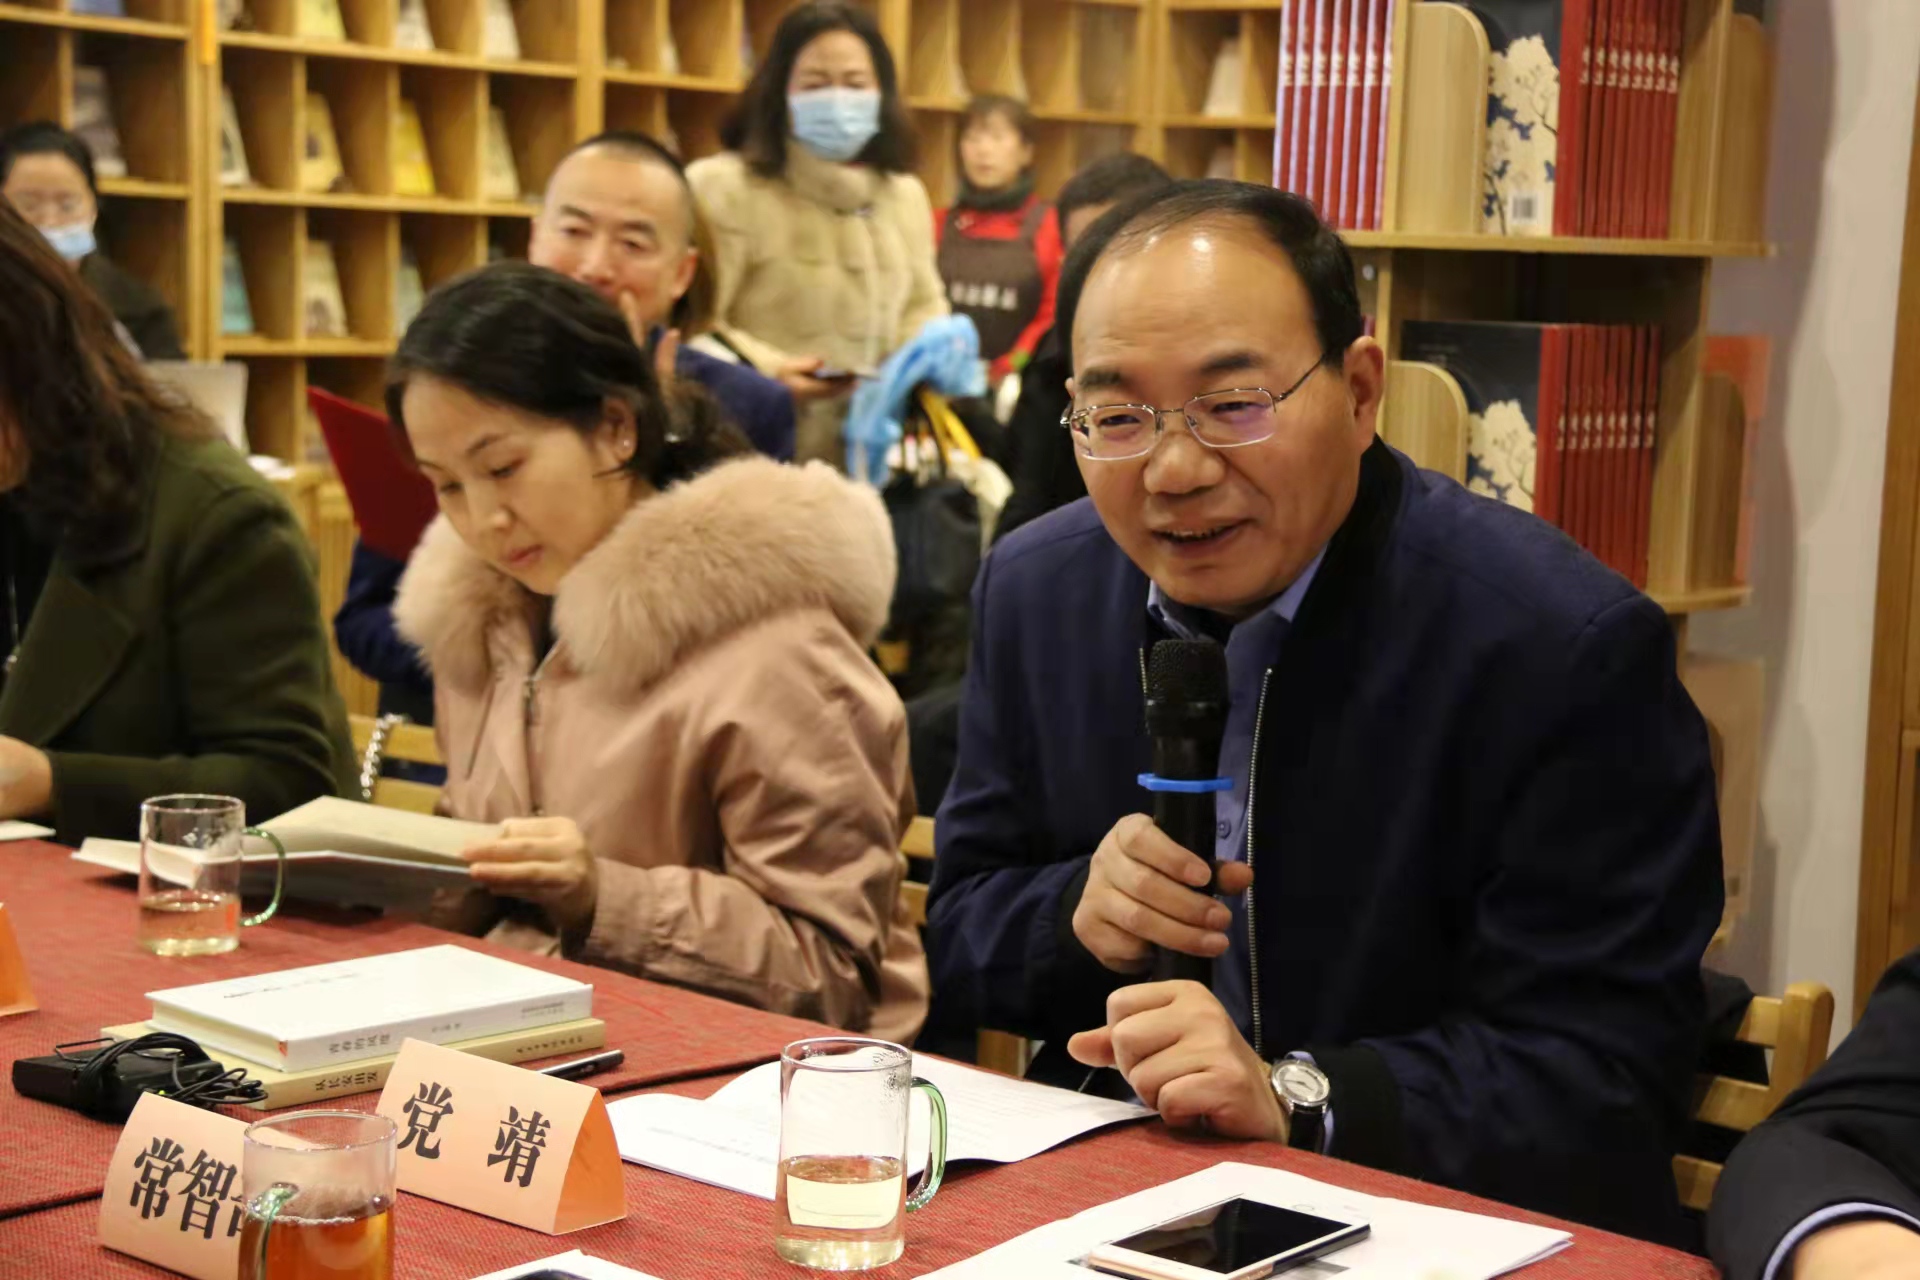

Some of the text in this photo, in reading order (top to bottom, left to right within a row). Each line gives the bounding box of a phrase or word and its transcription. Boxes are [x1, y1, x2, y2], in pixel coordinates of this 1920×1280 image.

[397, 1082, 454, 1159] 党
[487, 1106, 551, 1188] 靖
[130, 1136, 243, 1240] 常智
